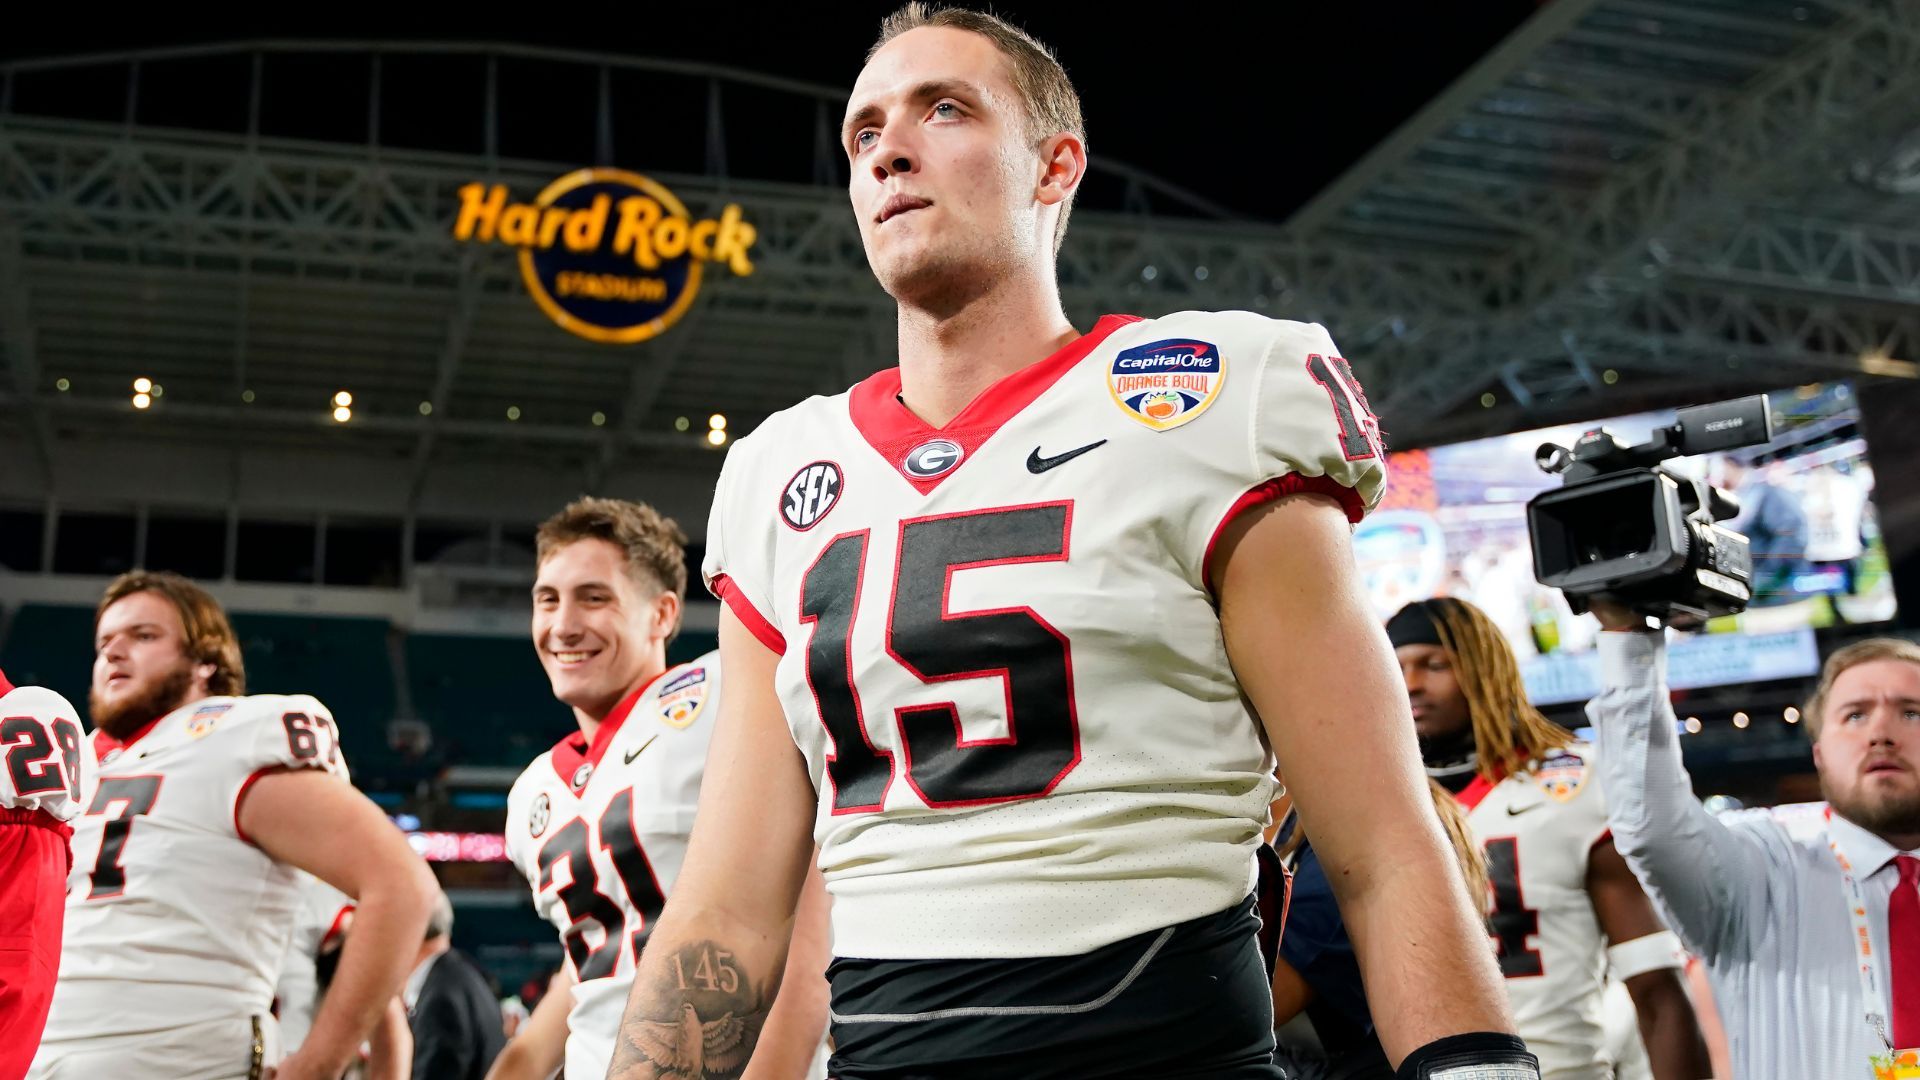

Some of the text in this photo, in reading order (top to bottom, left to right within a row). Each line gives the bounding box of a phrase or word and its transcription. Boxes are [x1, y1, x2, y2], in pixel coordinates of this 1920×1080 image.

[454, 182, 758, 276] Hard Rock
[1117, 374, 1209, 394] ORANGE BOWL
[783, 463, 840, 527] SEC
[905, 441, 960, 476] G
[799, 499, 1082, 816] 15
[0, 716, 81, 804] 28
[282, 711, 337, 766] 67
[67, 774, 165, 900] 7
[537, 785, 666, 983] 31
[672, 947, 739, 994] 145
